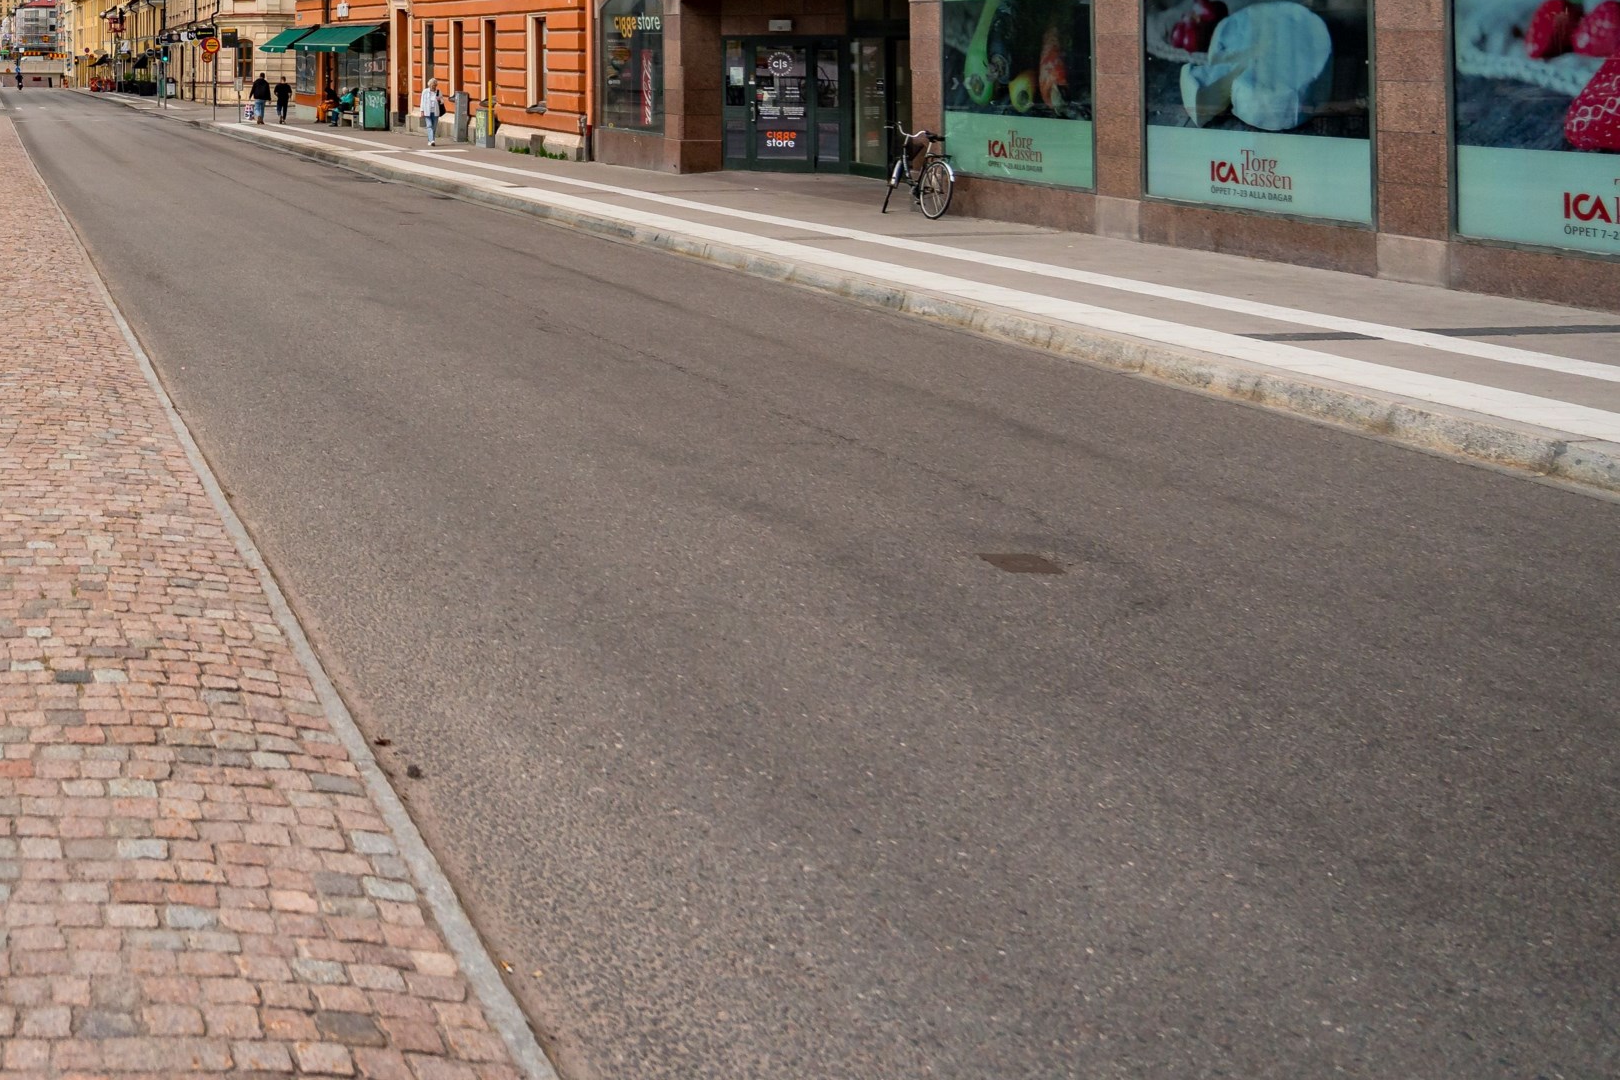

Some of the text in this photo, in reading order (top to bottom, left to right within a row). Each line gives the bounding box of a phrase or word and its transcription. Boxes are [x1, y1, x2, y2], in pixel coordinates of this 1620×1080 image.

[613, 12, 661, 38] cigge store
[766, 130, 797, 141] cigge
[766, 138, 795, 148] store
[988, 129, 1033, 159] ICA Torg
[1008, 141, 1043, 163] kassen
[1210, 149, 1278, 185] ICA Torg
[1241, 163, 1293, 191] kassen
[1210, 185, 1293, 203] ÖPPET 7-23 ALLA DAGAR
[1563, 191, 1613, 224] ICA
[1563, 223, 1599, 238] ÖPPET
